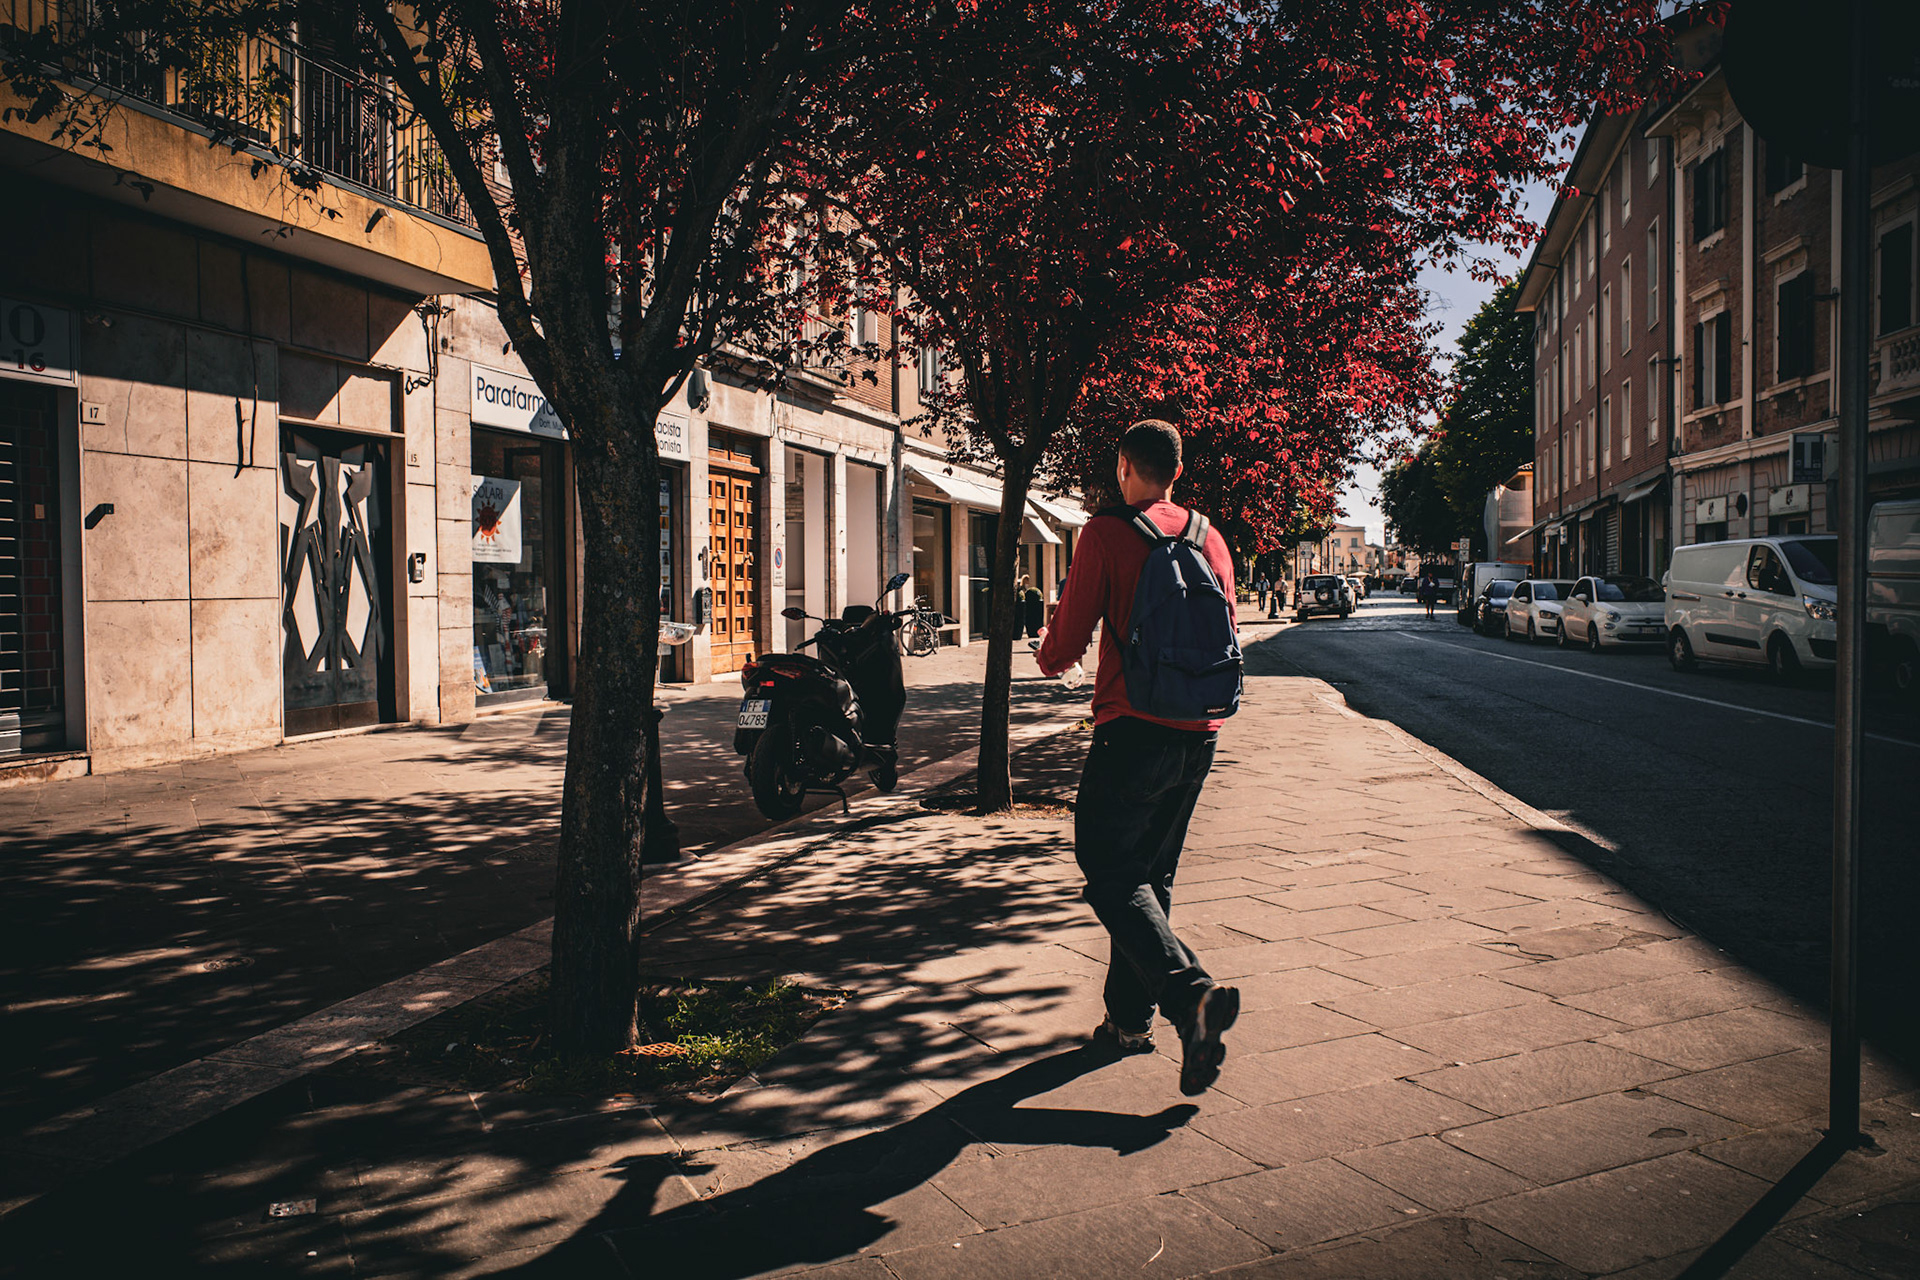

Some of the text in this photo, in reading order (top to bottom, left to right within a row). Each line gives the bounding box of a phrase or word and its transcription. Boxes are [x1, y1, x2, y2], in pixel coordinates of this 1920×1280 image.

[89, 407, 99, 419] 17
[410, 453, 418, 463] 15
[473, 485, 504, 500] SOLARI
[738, 714, 767, 726] 04783
